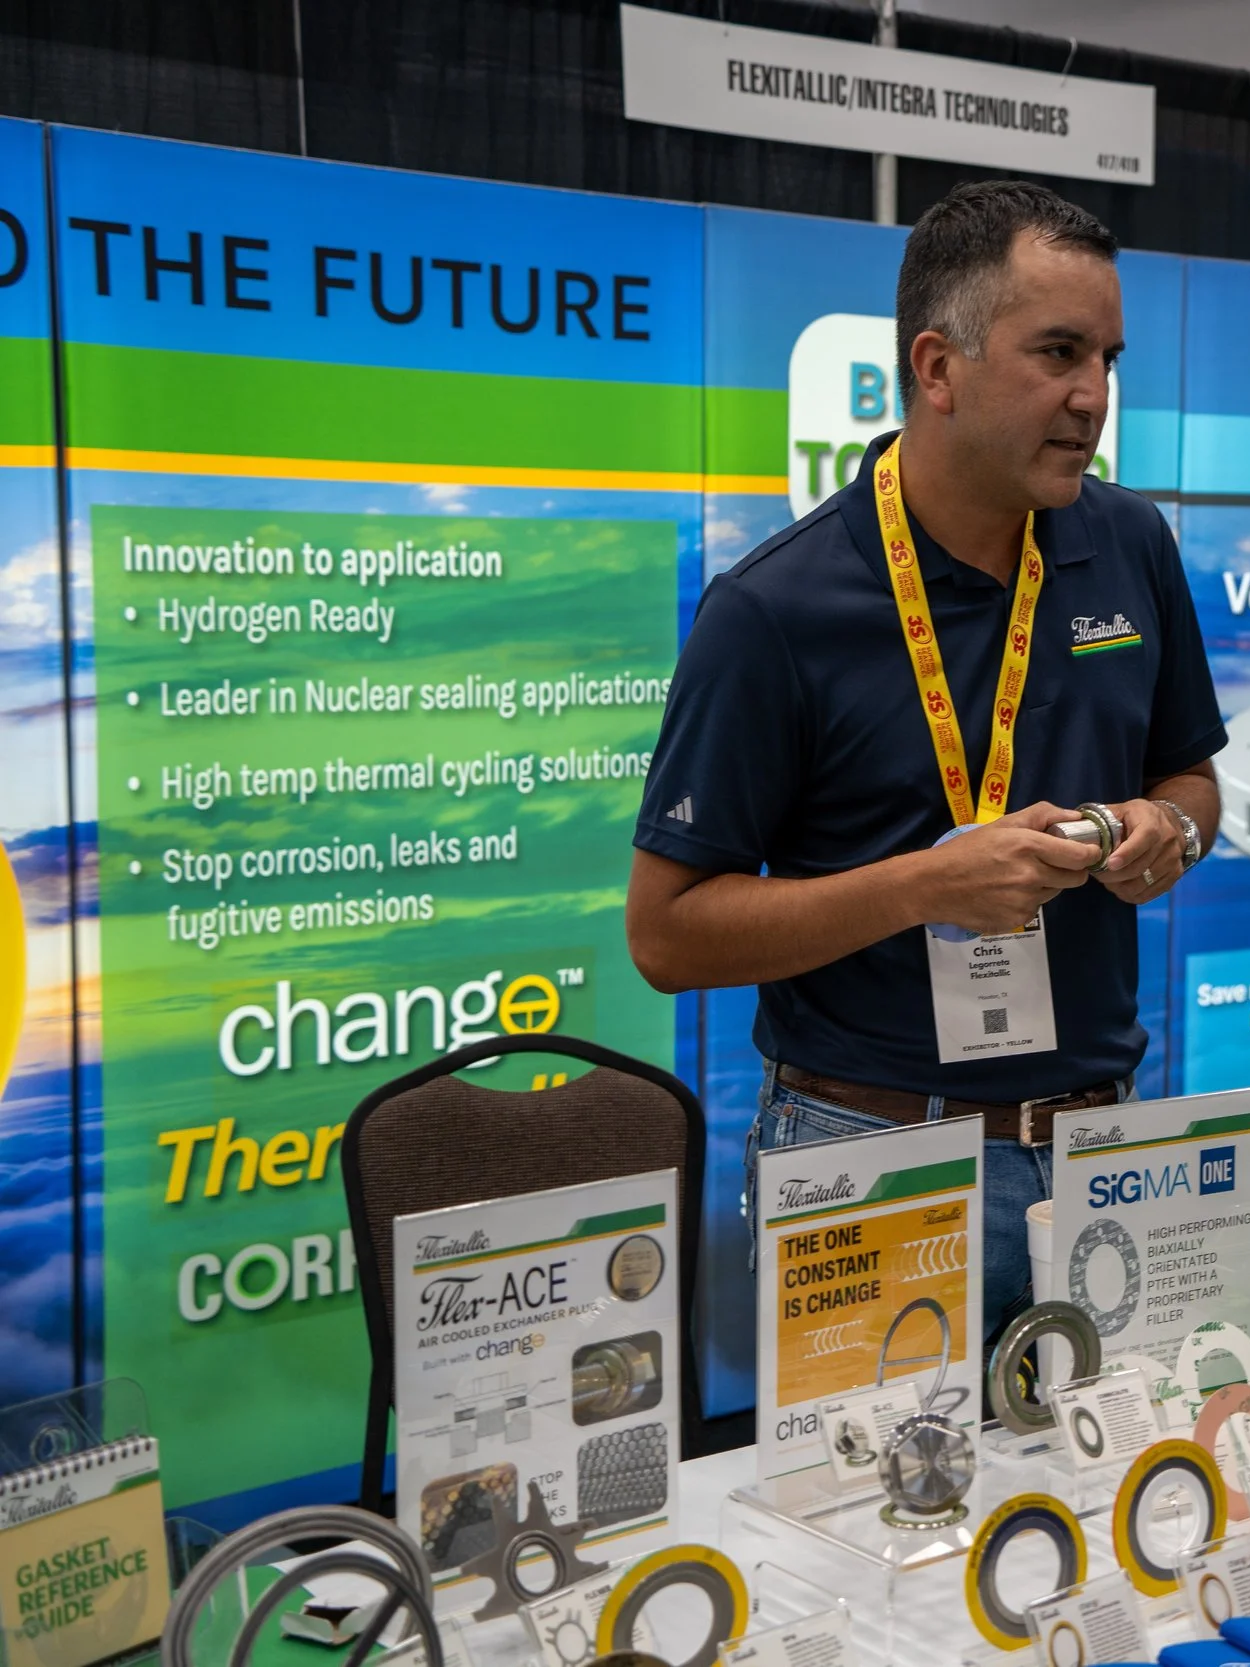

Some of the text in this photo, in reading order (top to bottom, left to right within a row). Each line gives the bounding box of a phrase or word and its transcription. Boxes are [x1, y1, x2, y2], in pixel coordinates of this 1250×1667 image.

[727, 59, 1070, 137] FLEXITALLIC/INTEGRA TECHNOLOGIES
[69, 216, 272, 312] THE
[313, 245, 651, 342] FUTURE
[123, 536, 502, 587] Innovation to application
[158, 596, 396, 644] Hydrogen Ready
[1071, 613, 1132, 643] Flexitallic
[160, 670, 673, 718] Leader in Nuclear sealing applications
[161, 747, 653, 810] High temp thermal cycling solutions
[162, 827, 518, 890] Stop corrosion, leaks and
[166, 888, 435, 950] fugitive emissions
[969, 959, 1010, 970] Legorreta
[973, 945, 1003, 957] Chris
[970, 970, 1011, 980] Flexitallic
[1197, 983, 1247, 1007] Save
[1068, 1125, 1125, 1149] Flexitallic
[1202, 1158, 1233, 1185] ONE
[777, 1172, 855, 1212] Flexitallic
[414, 1229, 490, 1261] Flexitallic
[784, 1224, 862, 1259] THE ONE
[1147, 1224, 1178, 1241] HIGH
[1147, 1238, 1205, 1258] BIAXIALLY
[784, 1250, 881, 1289] CONSTANT
[1147, 1252, 1218, 1275] ORIENTATED
[1147, 1269, 1218, 1292] PTFE WITH A
[416, 1260, 568, 1332] Flex-ACE
[784, 1280, 881, 1319] IS CHANGE
[1147, 1284, 1224, 1309] PROPRIETARY
[418, 1335, 439, 1349] AIR
[442, 1324, 490, 1345] COOLED
[494, 1309, 566, 1333] EXCHANGER
[1146, 1308, 1184, 1326] FILLER
[16, 1536, 110, 1588] GASKET
[18, 1549, 148, 1615] REFERENCE
[21, 1594, 95, 1640] GUIDE
